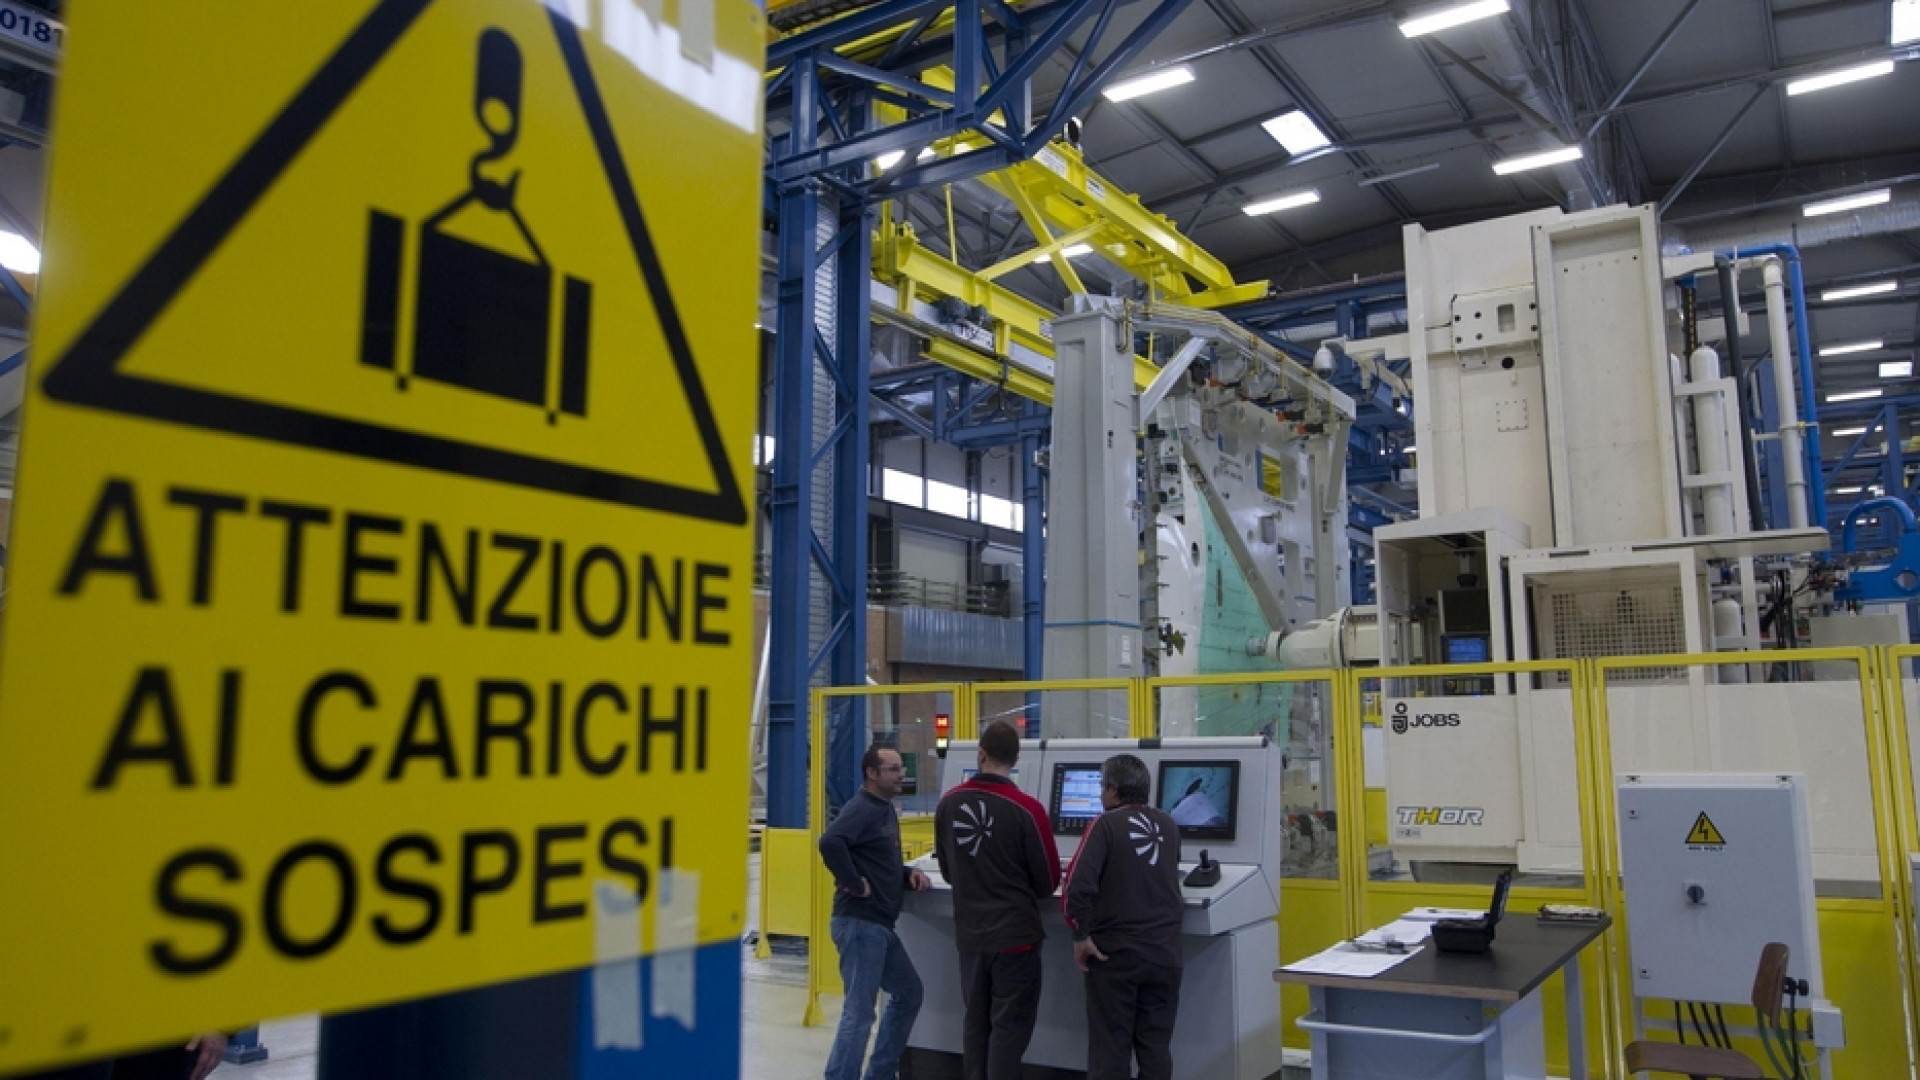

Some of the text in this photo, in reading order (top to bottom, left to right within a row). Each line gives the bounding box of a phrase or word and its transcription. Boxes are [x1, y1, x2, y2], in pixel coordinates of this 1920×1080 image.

[55, 477, 732, 647] ATTENZIONE
[87, 665, 709, 792] AI CARICHI
[1410, 713, 1461, 728] JOBS
[1397, 806, 1484, 826] THOR
[146, 816, 676, 979] SOSPESI
